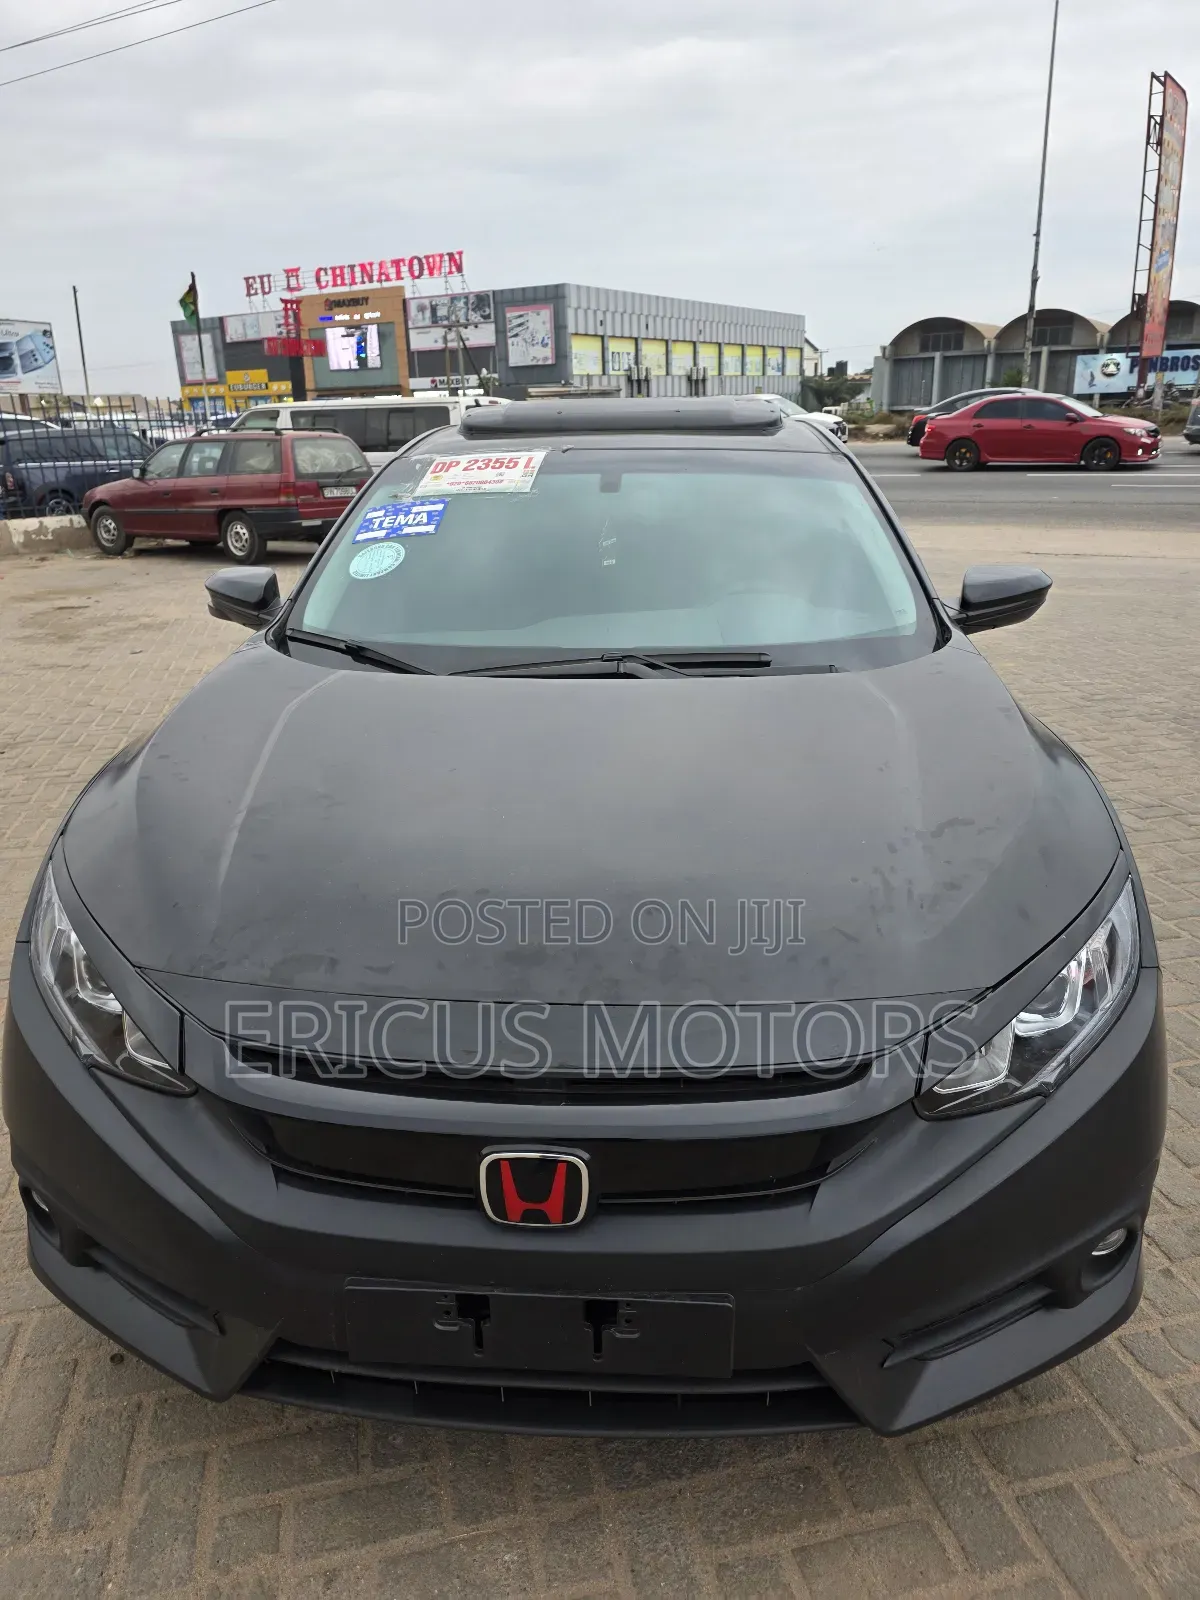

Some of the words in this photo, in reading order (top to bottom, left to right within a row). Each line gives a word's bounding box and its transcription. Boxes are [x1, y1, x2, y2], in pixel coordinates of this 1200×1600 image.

[243, 273, 272, 297] EU
[315, 250, 464, 290] CHINATOWN
[1129, 354, 1200, 374] PNBROS
[438, 377, 471, 387] MXBY
[430, 460, 461, 475] DP
[462, 456, 522, 472] 2355
[372, 512, 428, 529] TEMA
